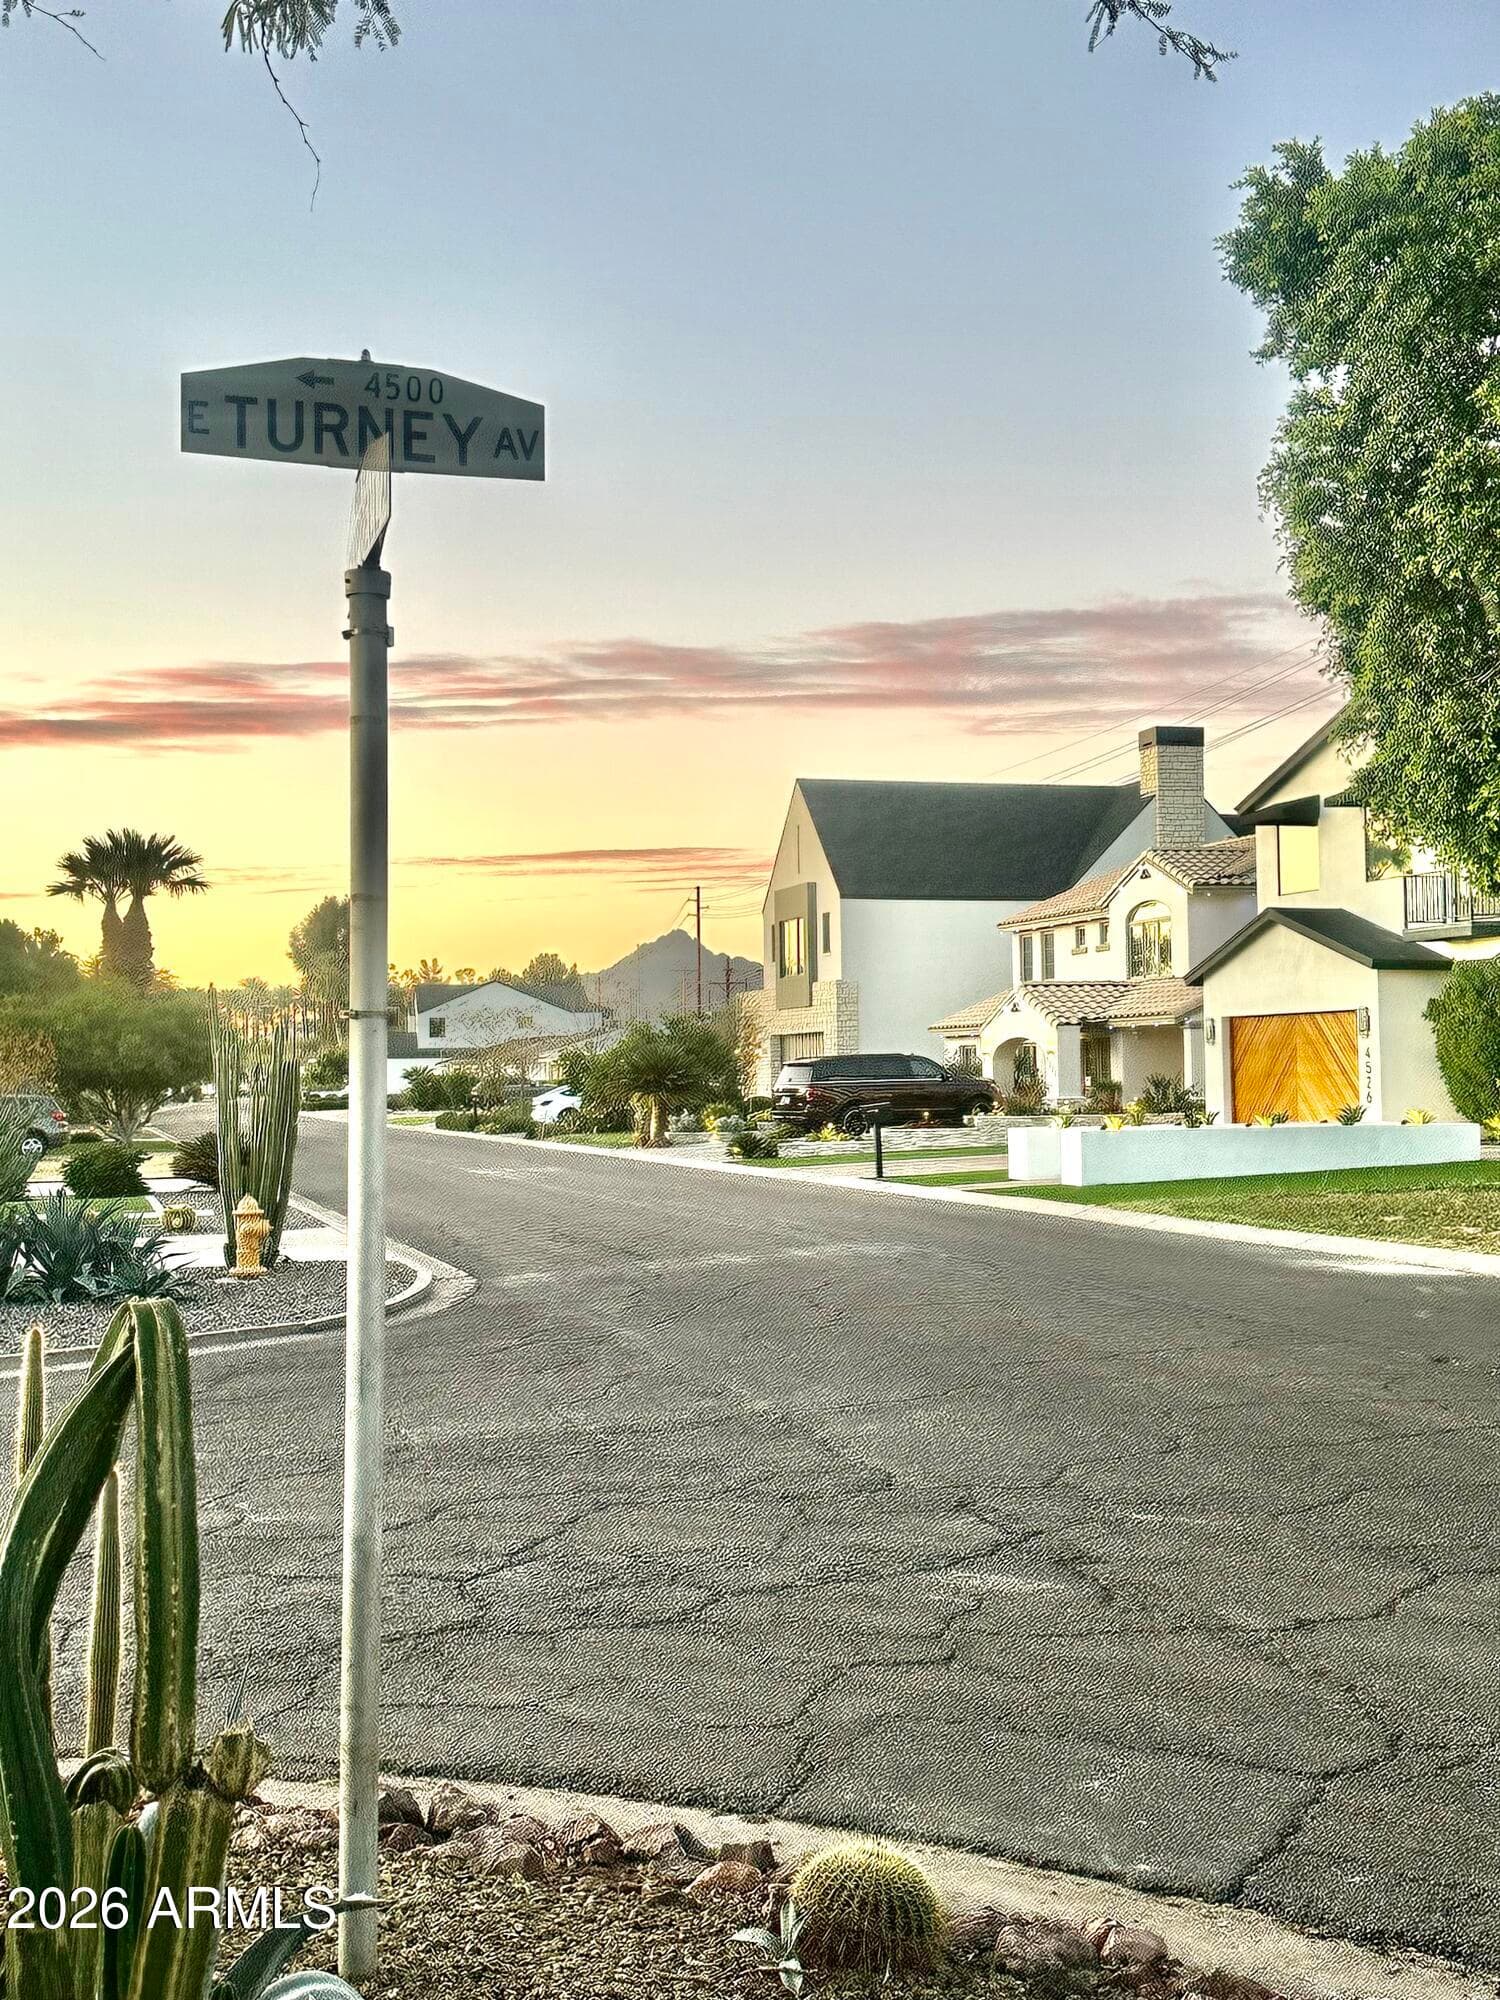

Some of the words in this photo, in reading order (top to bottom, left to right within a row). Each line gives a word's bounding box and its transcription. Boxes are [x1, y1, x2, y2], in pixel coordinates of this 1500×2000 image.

[363, 371, 444, 404] 4500
[187, 399, 210, 435] E
[224, 394, 484, 467] TURNEY
[493, 426, 540, 462] AV
